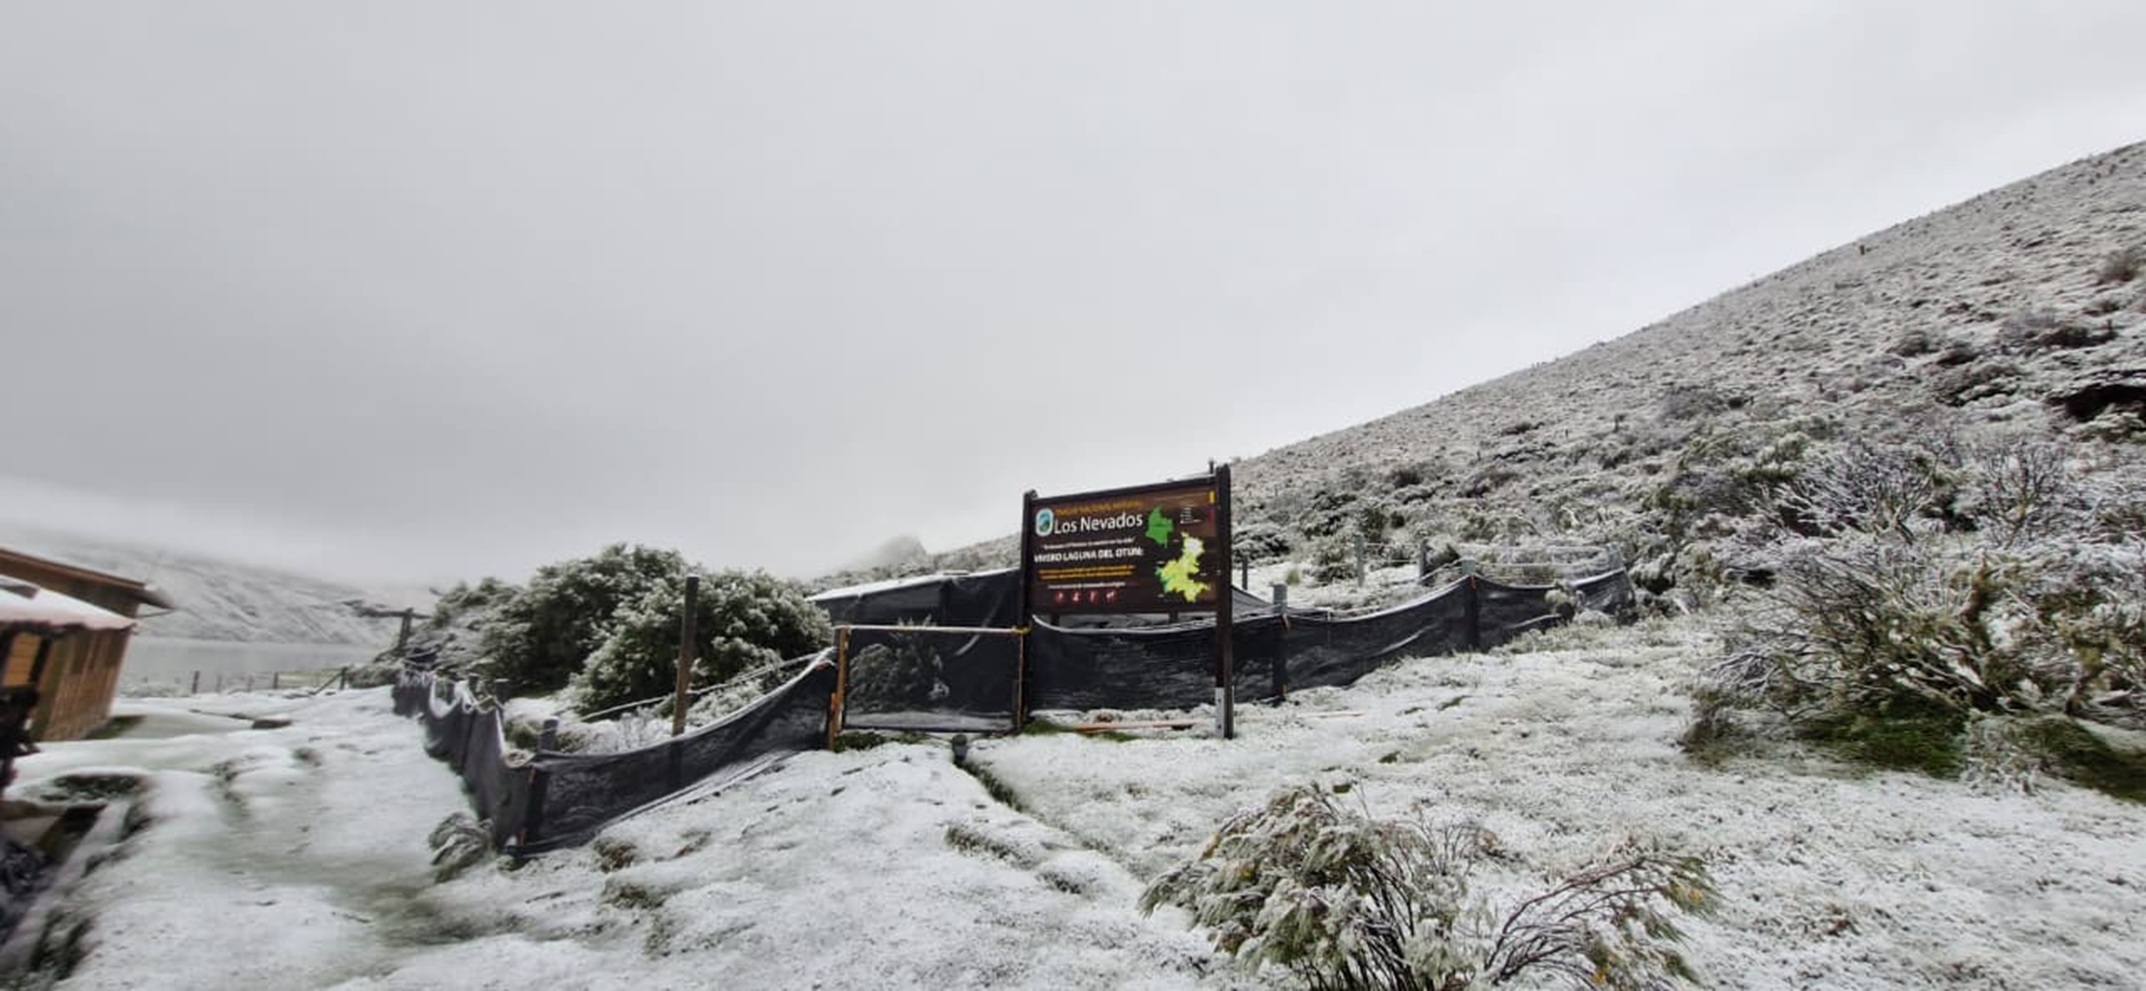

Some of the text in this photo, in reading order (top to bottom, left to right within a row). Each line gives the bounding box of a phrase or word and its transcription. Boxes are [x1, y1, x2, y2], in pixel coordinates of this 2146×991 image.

[1054, 511, 1143, 534] Los Nevados
[1063, 550, 1097, 561] LAGUNA
[1098, 548, 1114, 559] DEL
